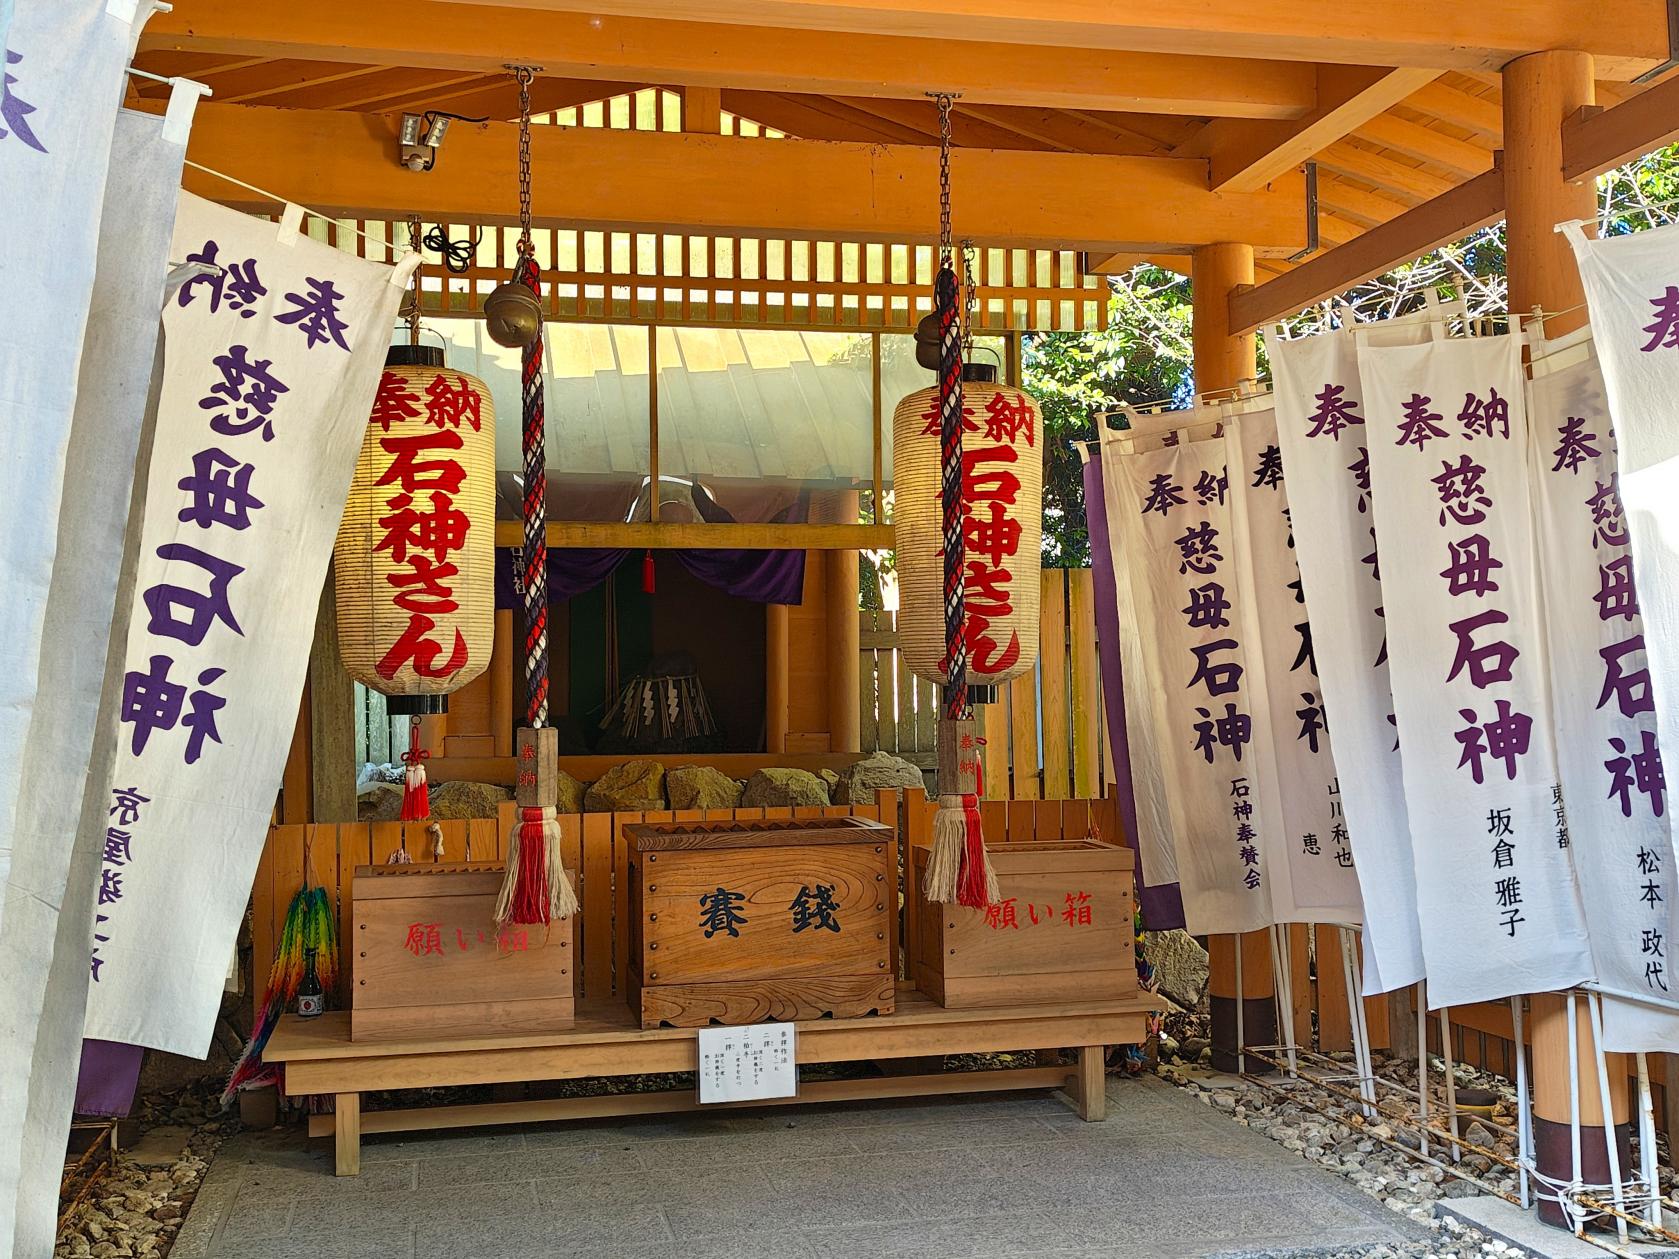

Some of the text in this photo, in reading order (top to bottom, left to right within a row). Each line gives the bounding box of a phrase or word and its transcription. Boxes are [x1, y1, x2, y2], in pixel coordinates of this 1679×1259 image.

[369, 371, 481, 433] 奉納
[1305, 384, 1366, 442] 奉
[1395, 387, 1510, 453] 奉納
[1552, 417, 1618, 476] 奉
[1141, 465, 1229, 517] 奉納
[371, 429, 471, 680] 石神さん
[1174, 520, 1253, 765] 慈母石神
[1430, 454, 1533, 784] 慈母石神
[1585, 472, 1667, 818] 慈母石神
[519, 743, 536, 786] 奉納
[960, 733, 975, 775] 奉納
[1230, 777, 1260, 890] 石神奉賛会
[1303, 833, 1321, 856] 恵
[983, 891, 1093, 930] 願い箱
